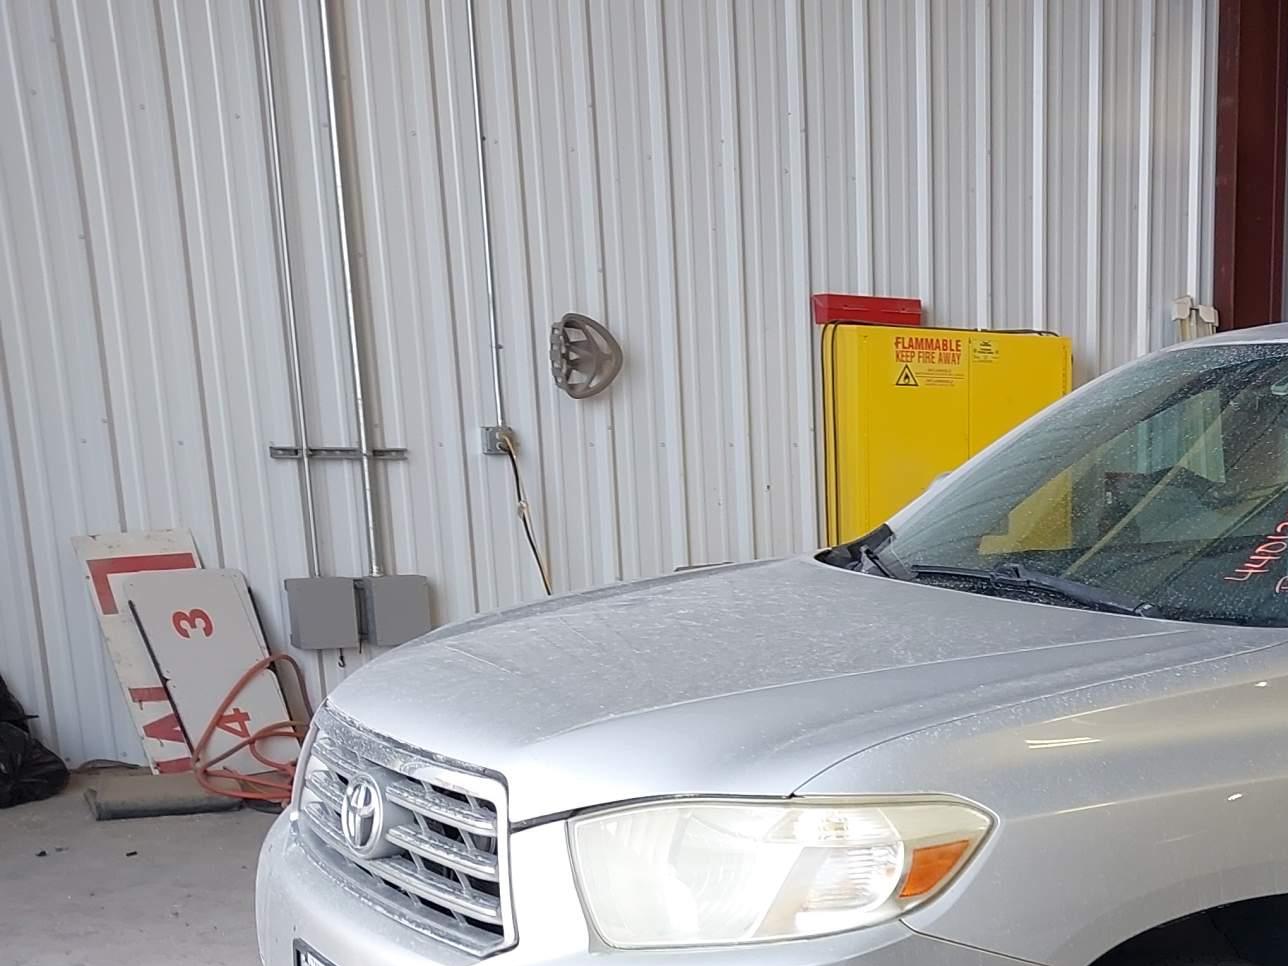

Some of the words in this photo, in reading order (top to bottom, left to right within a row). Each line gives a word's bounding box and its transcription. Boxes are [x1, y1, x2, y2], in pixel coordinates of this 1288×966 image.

[895, 337, 961, 352] FLAMMABLE
[896, 351, 915, 363] KEEP
[918, 352, 936, 364] FIRE
[938, 353, 961, 365] AWAY
[172, 608, 214, 638] 3
[215, 707, 251, 739] 4
